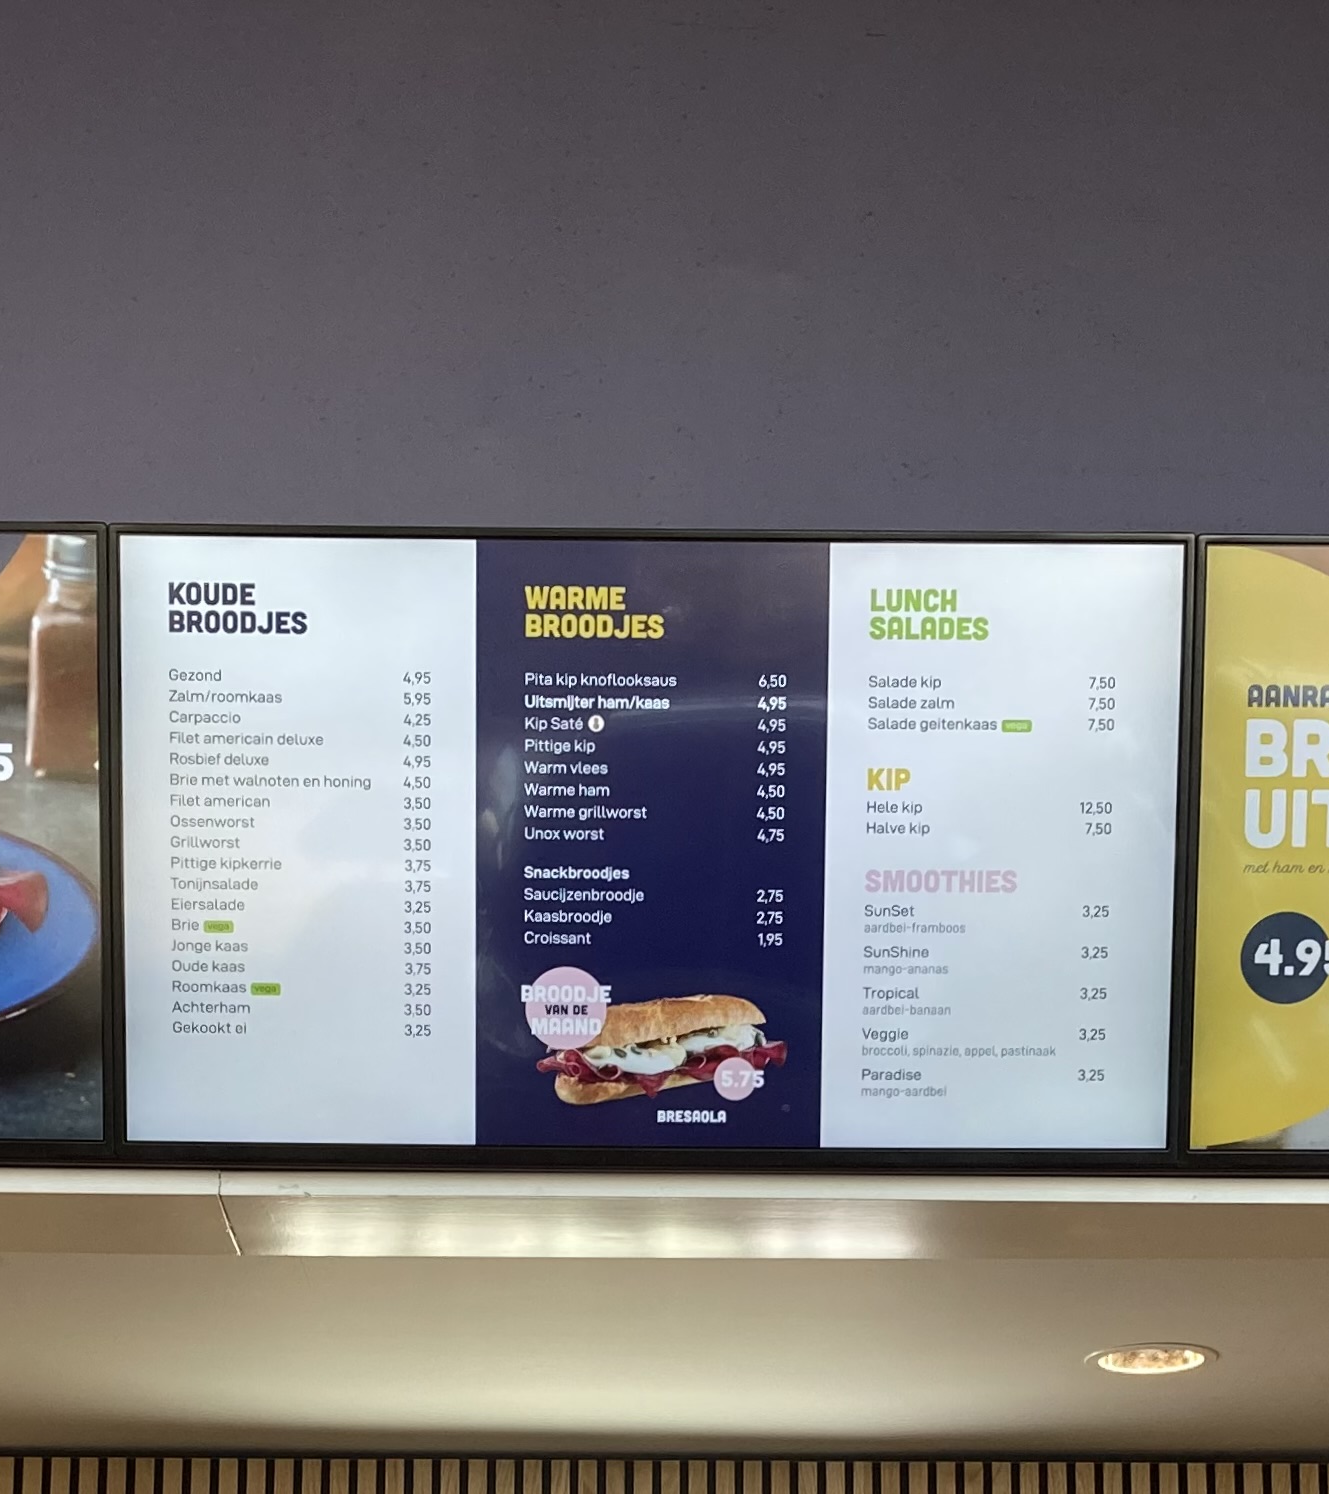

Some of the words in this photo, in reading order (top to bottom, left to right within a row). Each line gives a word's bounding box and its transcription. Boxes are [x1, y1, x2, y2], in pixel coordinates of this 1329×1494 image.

[168, 582, 255, 605] KOUDE
[525, 586, 626, 610] WARME
[870, 589, 957, 612] LUNCH
[168, 611, 308, 634] BROODJES
[525, 614, 664, 638] BROODJES
[869, 617, 989, 641] SALADES
[169, 669, 222, 682] Gezond
[403, 672, 431, 686] 4,95
[524, 672, 553, 687] Pita
[556, 672, 577, 689] kip
[580, 672, 677, 688] knoflooksaus
[758, 674, 786, 689] 6,50
[868, 675, 915, 689] Salade
[918, 675, 942, 692] kip
[1088, 677, 1116, 692] 7,50
[169, 690, 282, 704] Zalm/roomkaas
[404, 692, 431, 706] 5,95
[867, 768, 911, 791] KIP
[524, 805, 574, 820] Warme
[578, 805, 647, 822] grillworst
[757, 806, 784, 822] 4,50
[866, 801, 898, 815] Hele
[902, 800, 923, 817] kip
[1080, 802, 1112, 816] 12,50
[170, 815, 255, 829] Ossenworst
[404, 817, 431, 832] 3,50
[524, 866, 630, 883] Snackbroodjes
[1243, 862, 1268, 874] met
[1271, 862, 1303, 875] ham
[1307, 864, 1325, 875] en
[170, 877, 258, 892] Tonijnsalade
[404, 879, 431, 894] 3,75
[865, 870, 1017, 894] SMOOTHIES
[524, 887, 644, 904] Saucijzenbroodje
[757, 888, 783, 904] 2,75
[864, 904, 914, 918] SunSet
[1082, 906, 1109, 920] 3,25
[524, 931, 591, 946] Croissant
[758, 932, 782, 948] 1,95
[863, 946, 929, 960] SunShine
[1081, 947, 1108, 961] 3,25
[521, 985, 611, 1003] BROODJE
[172, 1001, 250, 1015] Achterham
[404, 1004, 431, 1018] 3,50
[545, 1005, 569, 1016] VAN
[572, 1005, 588, 1015] DE
[531, 1017, 602, 1035] MAAND
[862, 1028, 909, 1044] Veggie
[1078, 1029, 1106, 1043] 3,25
[721, 1071, 764, 1089] 5.75
[861, 1069, 922, 1082] Paradise
[1077, 1070, 1105, 1084] 3,25
[657, 1110, 726, 1123] BRESAOLA
